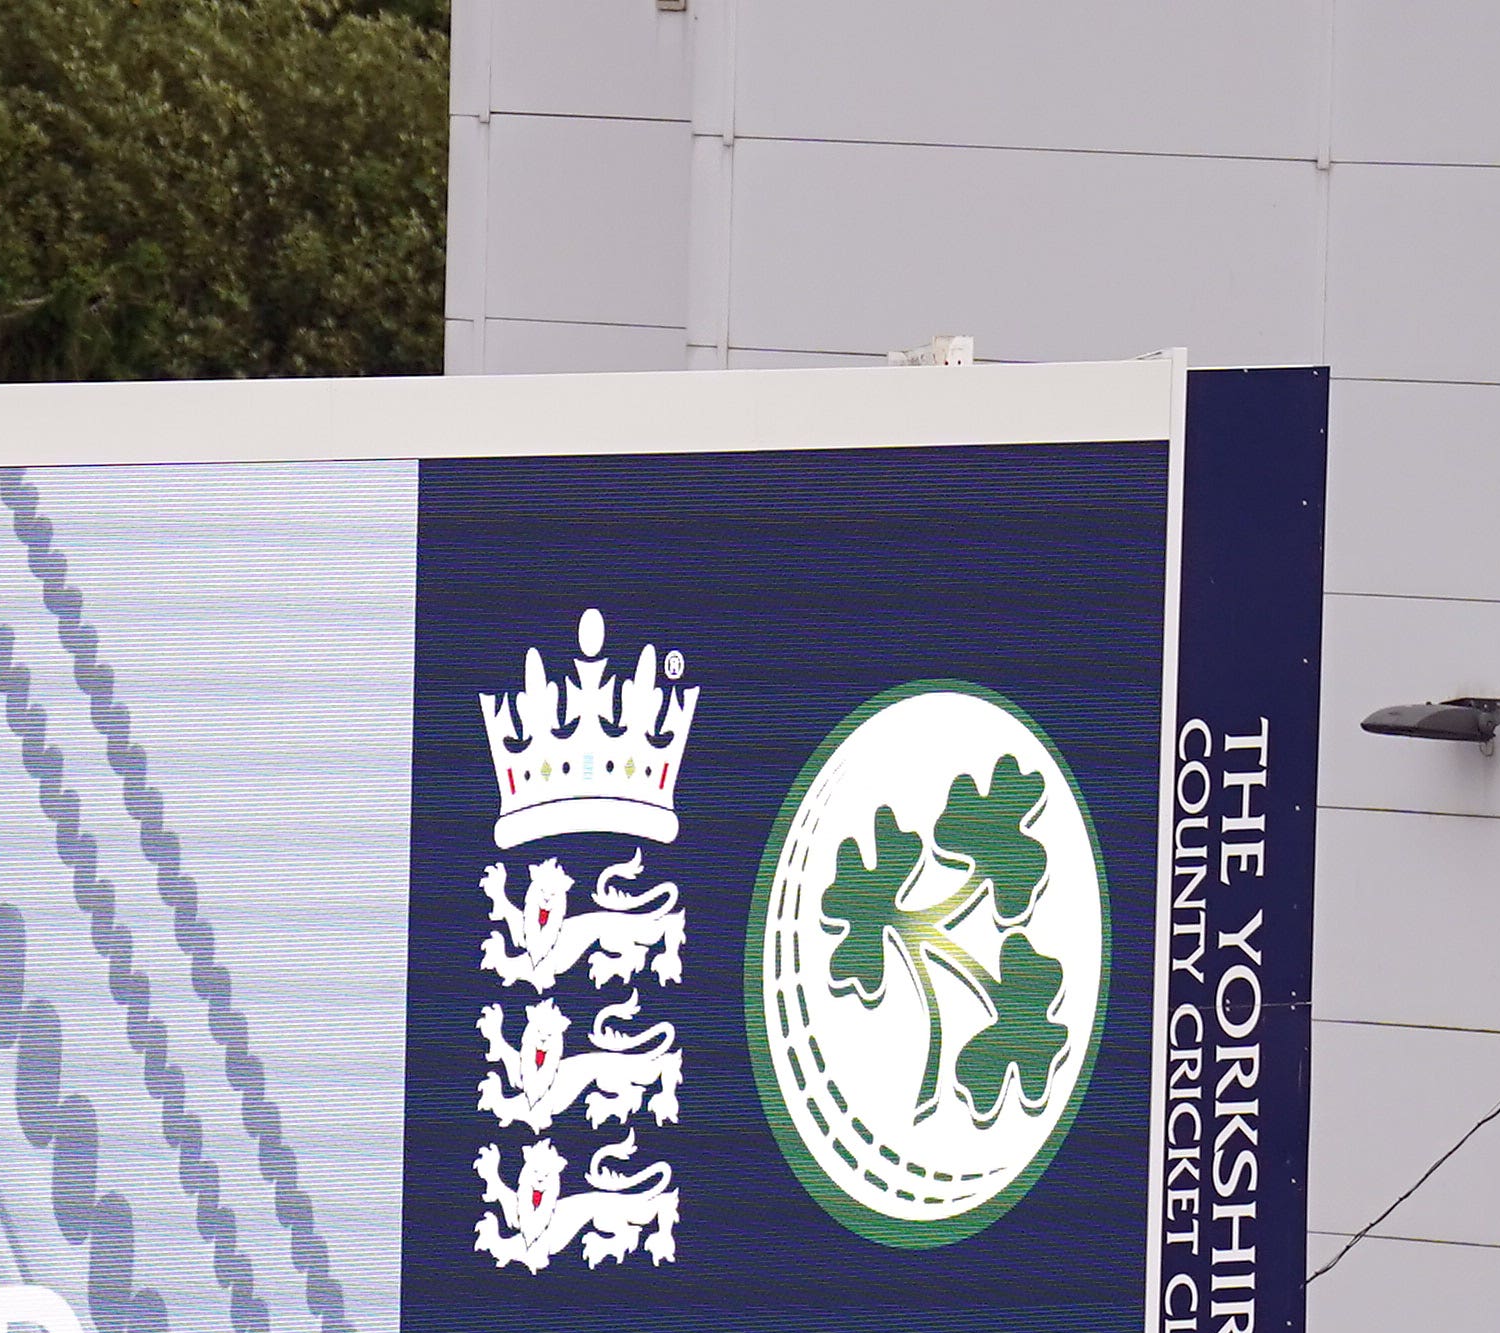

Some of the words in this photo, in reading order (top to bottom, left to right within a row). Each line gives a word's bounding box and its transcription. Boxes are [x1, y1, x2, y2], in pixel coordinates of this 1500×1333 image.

[1169, 718, 1211, 985] COUNTY
[1221, 717, 1268, 885] THE
[1167, 1005, 1203, 1256] CRICKET
